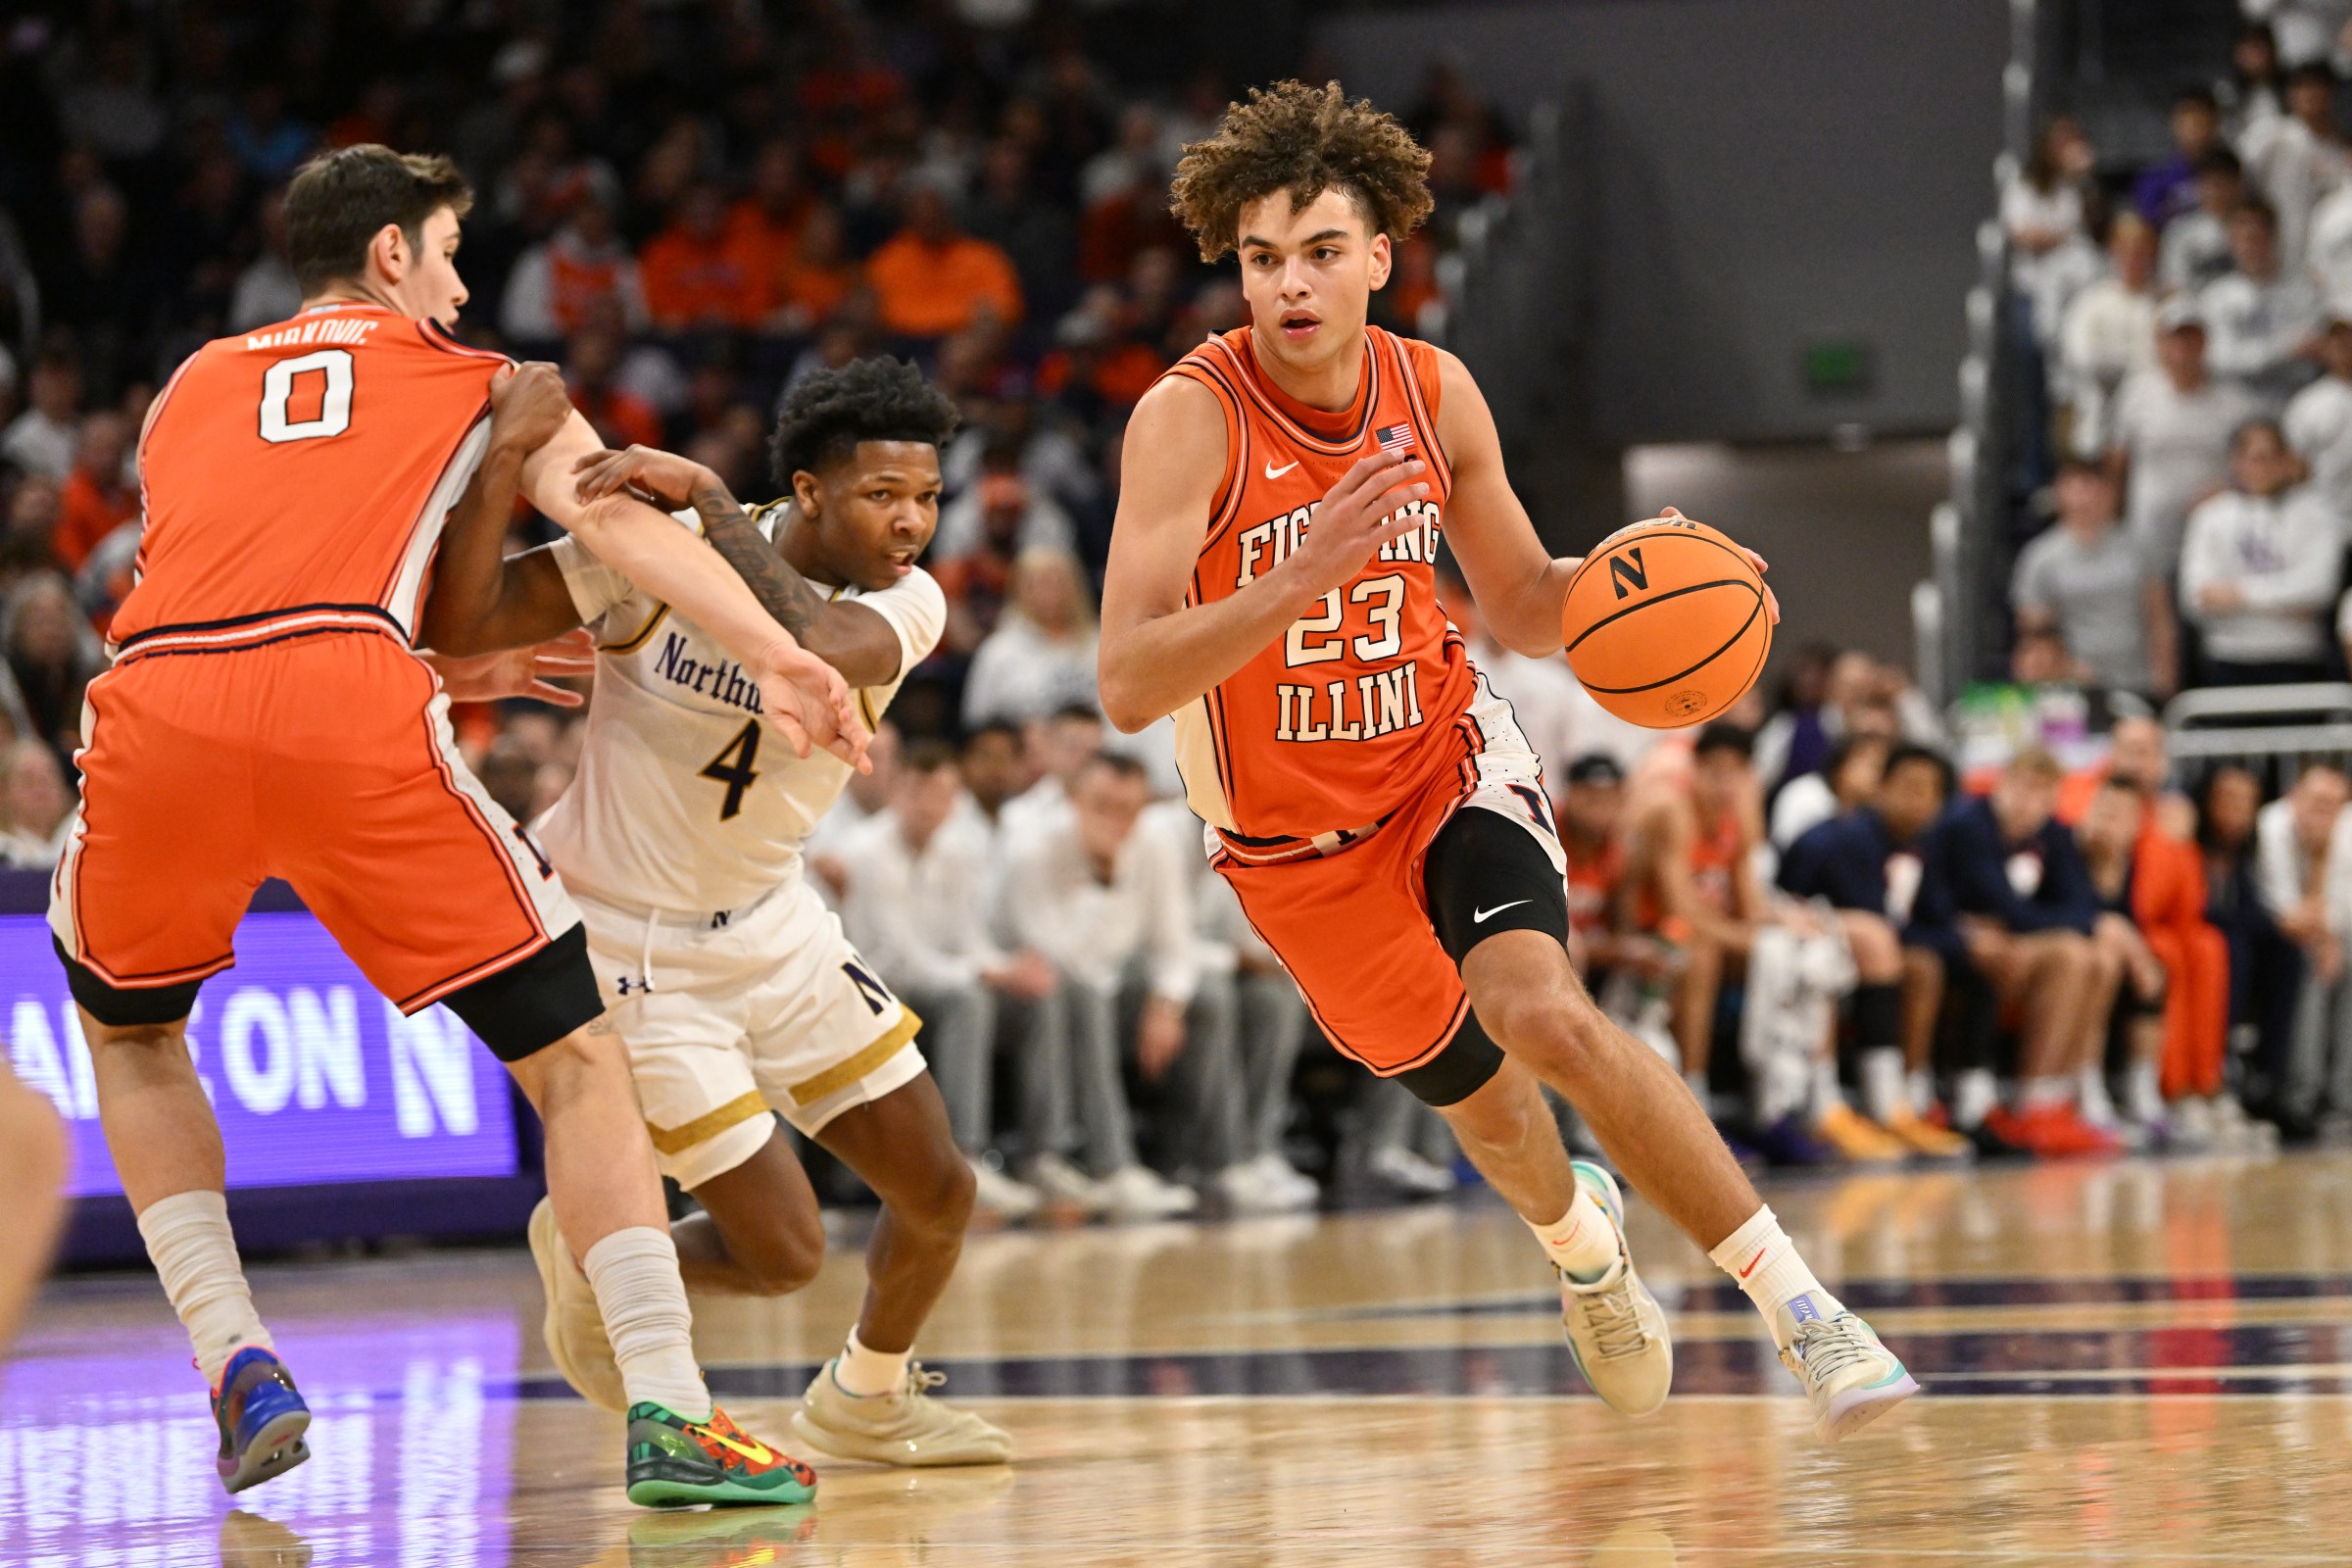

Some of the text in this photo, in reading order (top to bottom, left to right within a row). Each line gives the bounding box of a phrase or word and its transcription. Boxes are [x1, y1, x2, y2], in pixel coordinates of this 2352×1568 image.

[258, 348, 356, 443] 0
[1236, 499, 1443, 589] FIGING
[1609, 547, 1648, 600] N
[1285, 572, 1406, 668] 23
[1275, 660, 1424, 744] ILLINI
[695, 717, 762, 822] 4
[220, 985, 368, 1116] ON
[383, 990, 479, 1139] N
